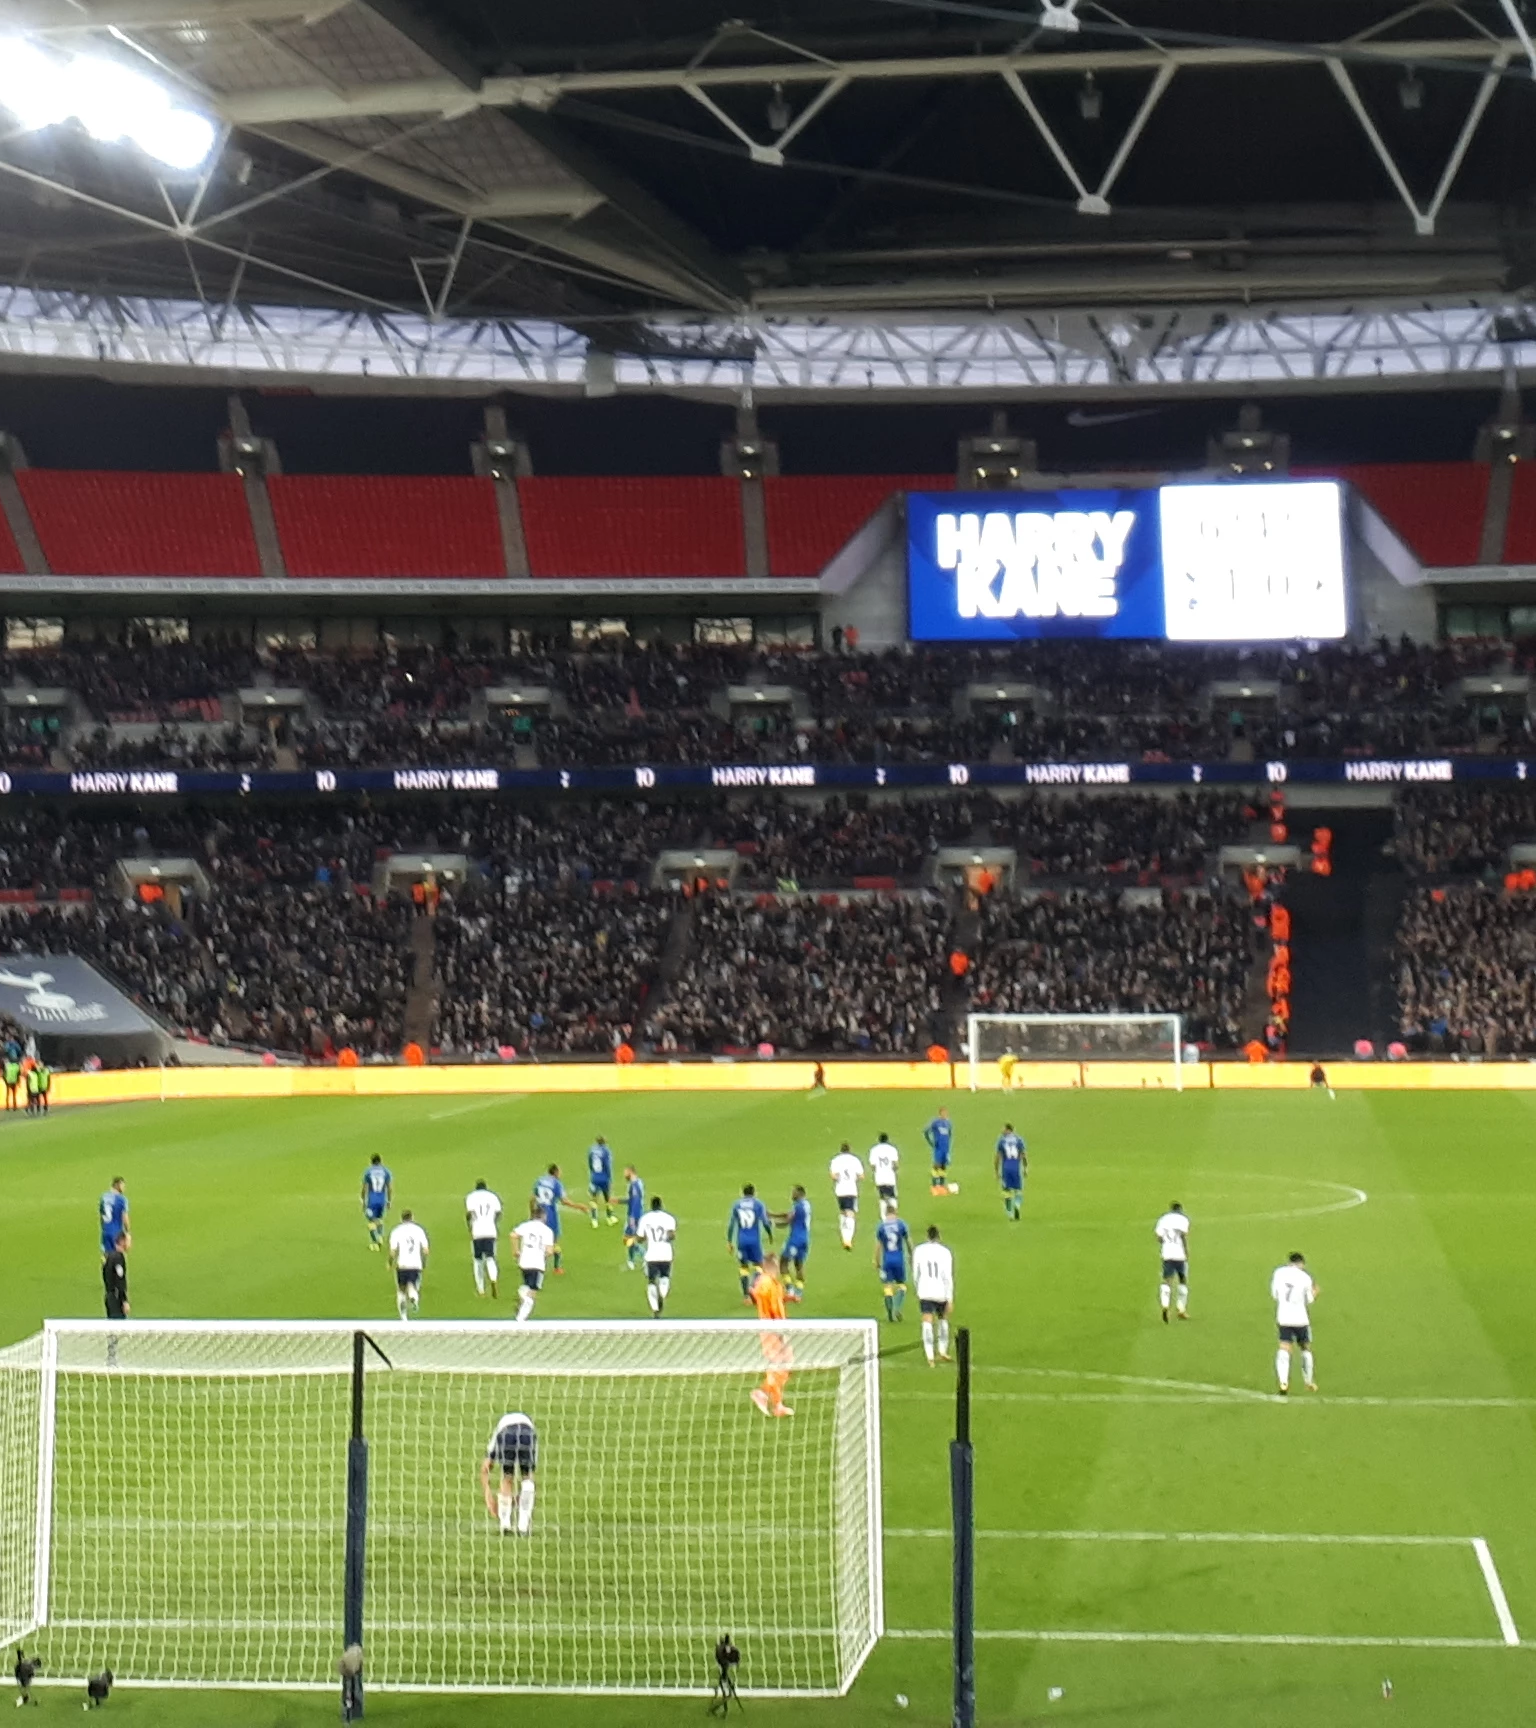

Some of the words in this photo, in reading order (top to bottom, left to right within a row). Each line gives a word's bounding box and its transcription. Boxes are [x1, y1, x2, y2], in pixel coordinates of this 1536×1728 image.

[936, 511, 1135, 569] HARRY
[957, 562, 1120, 619] KANE
[394, 770, 450, 789] HARRY
[450, 770, 498, 789] KANE
[636, 768, 655, 787] 10
[712, 767, 767, 785] HARRY
[767, 766, 815, 785] KANE
[949, 764, 969, 784] 10
[1026, 764, 1081, 783] HARRY
[1081, 764, 1129, 783] KANE
[1266, 762, 1287, 782] 10
[1346, 762, 1402, 780] HARRY
[1402, 761, 1452, 780] KANE
[71, 773, 128, 792] HARRY
[130, 772, 177, 792] KANE
[316, 771, 336, 791] 10
[650, 1225, 664, 1242] 12
[927, 1260, 939, 1279] 11
[1284, 1283, 1294, 1302] 7
